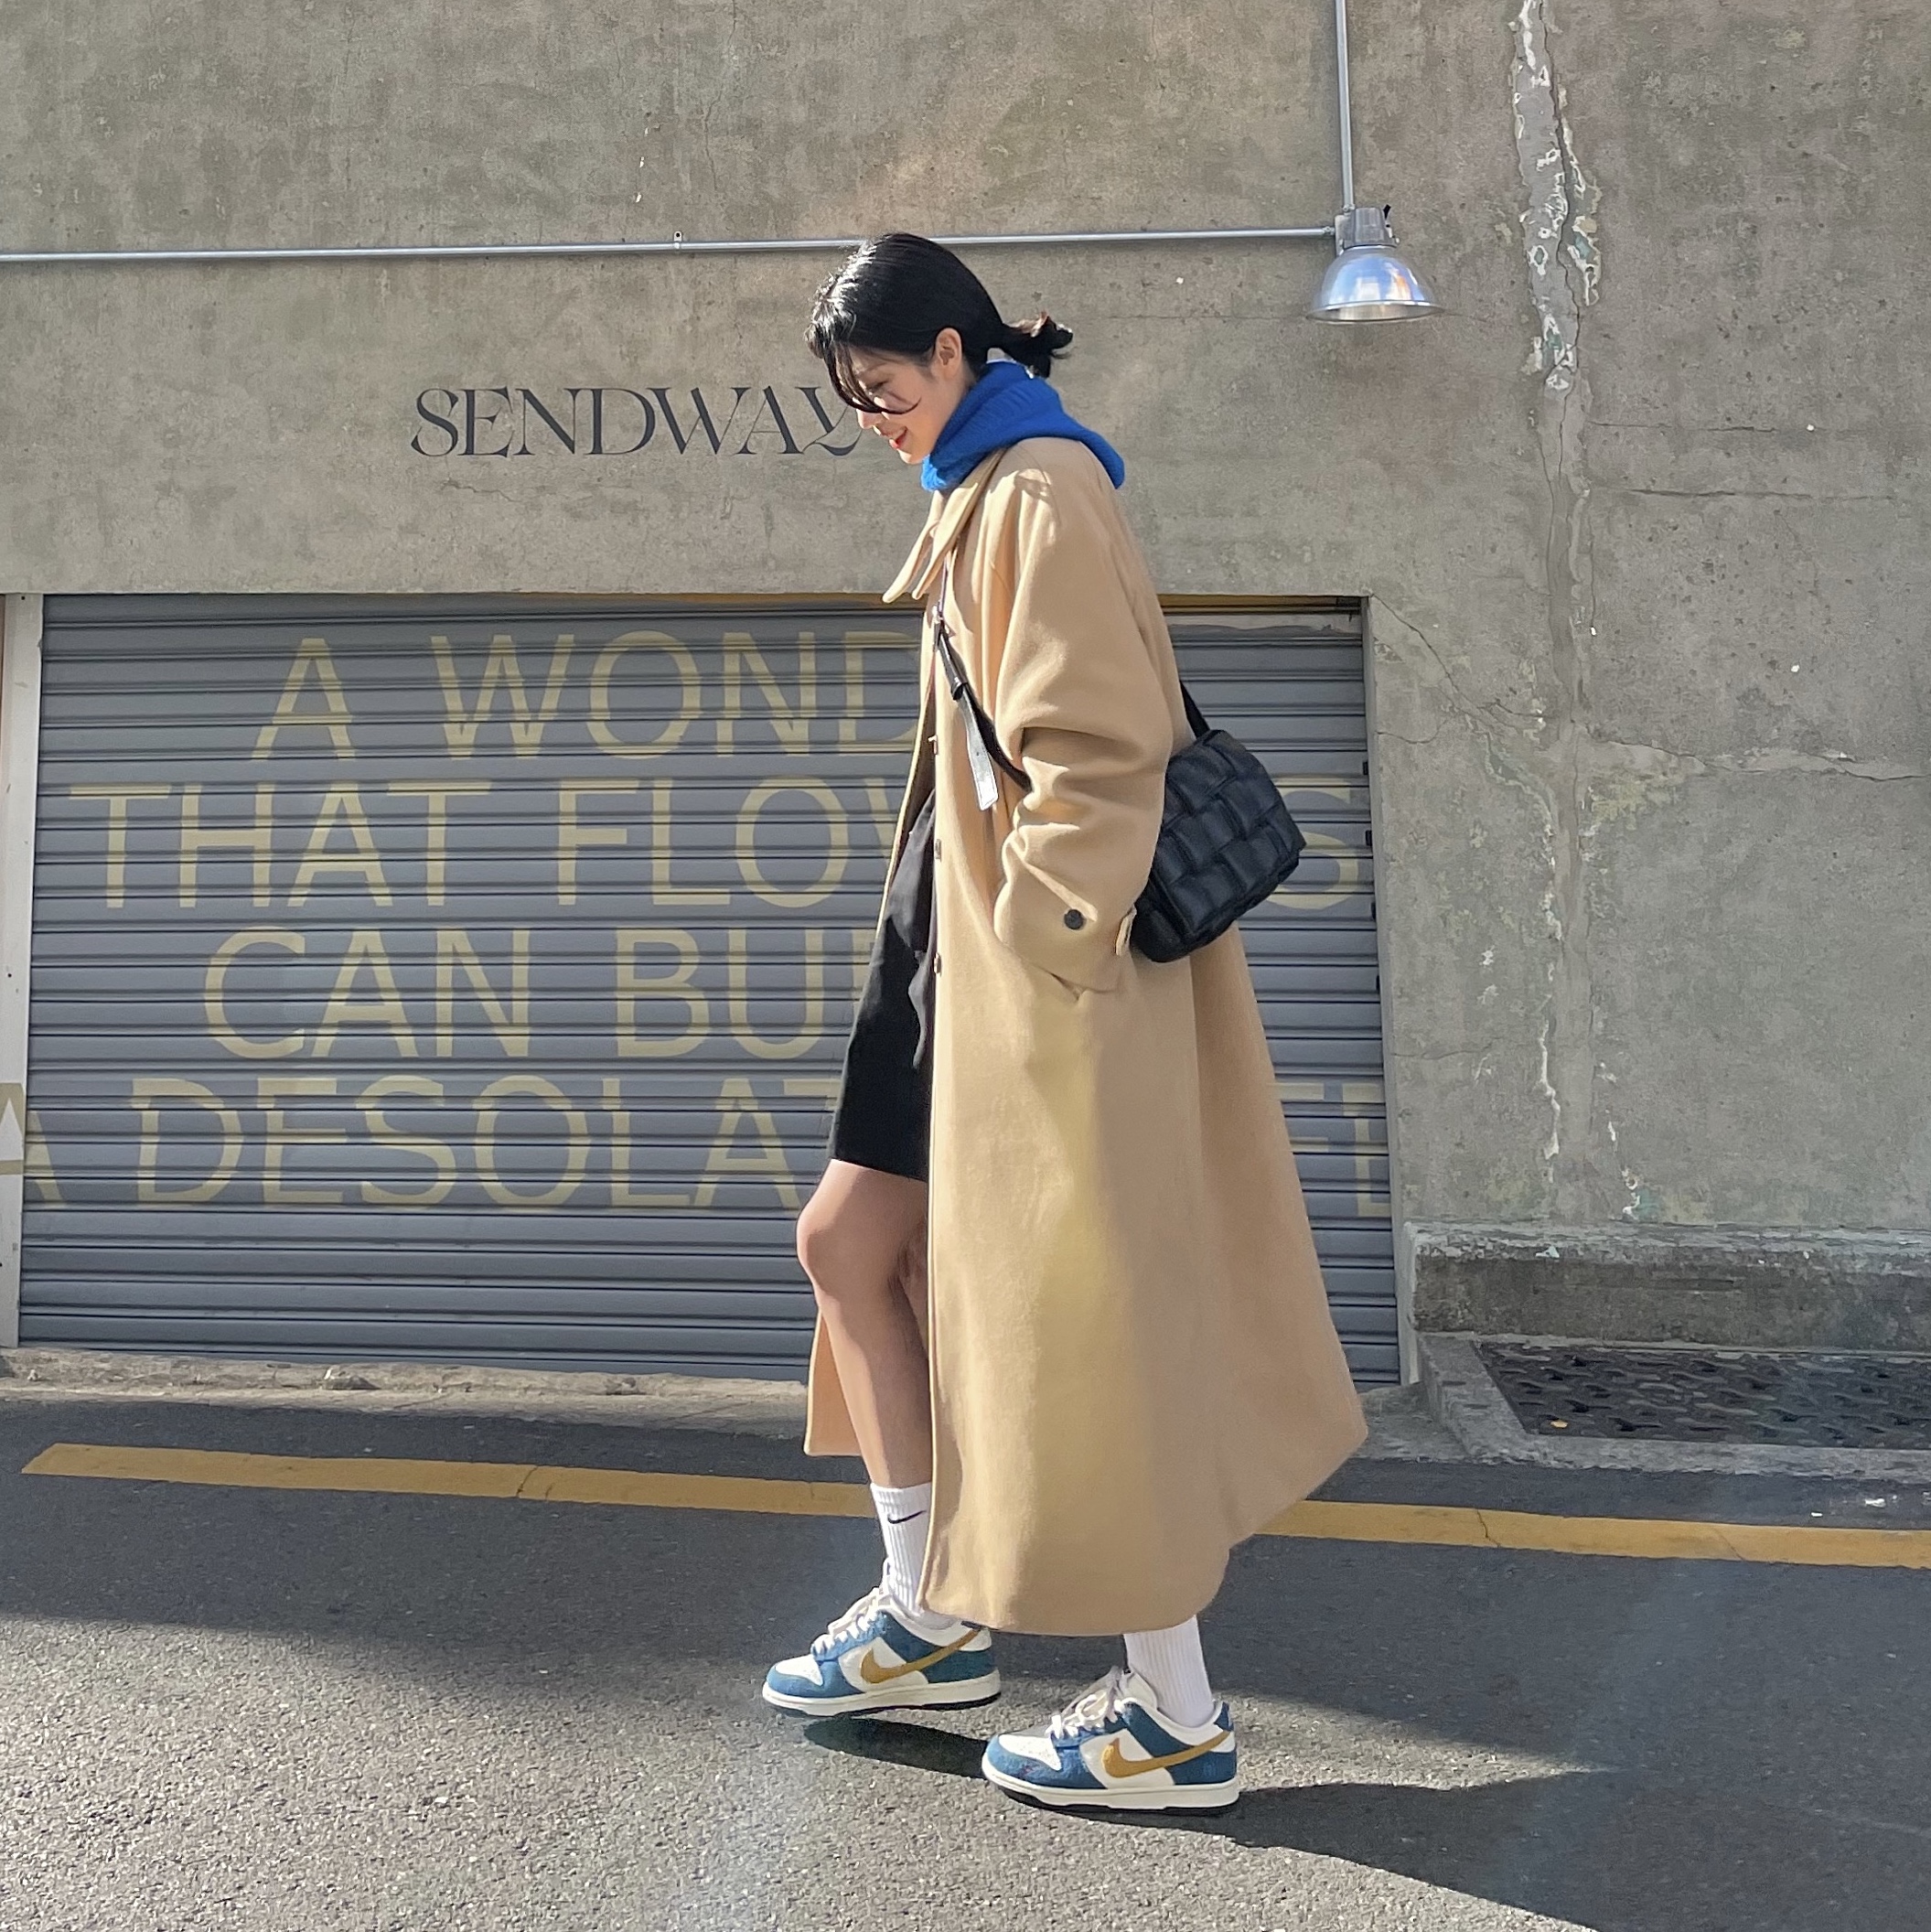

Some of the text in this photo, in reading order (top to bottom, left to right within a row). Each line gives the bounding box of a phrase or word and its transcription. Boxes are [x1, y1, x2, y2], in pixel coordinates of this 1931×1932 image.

[411, 385, 864, 457] SENDWAY
[252, 629, 920, 760] A WOND
[69, 779, 491, 908] THAT
[204, 926, 531, 1058] CAN
